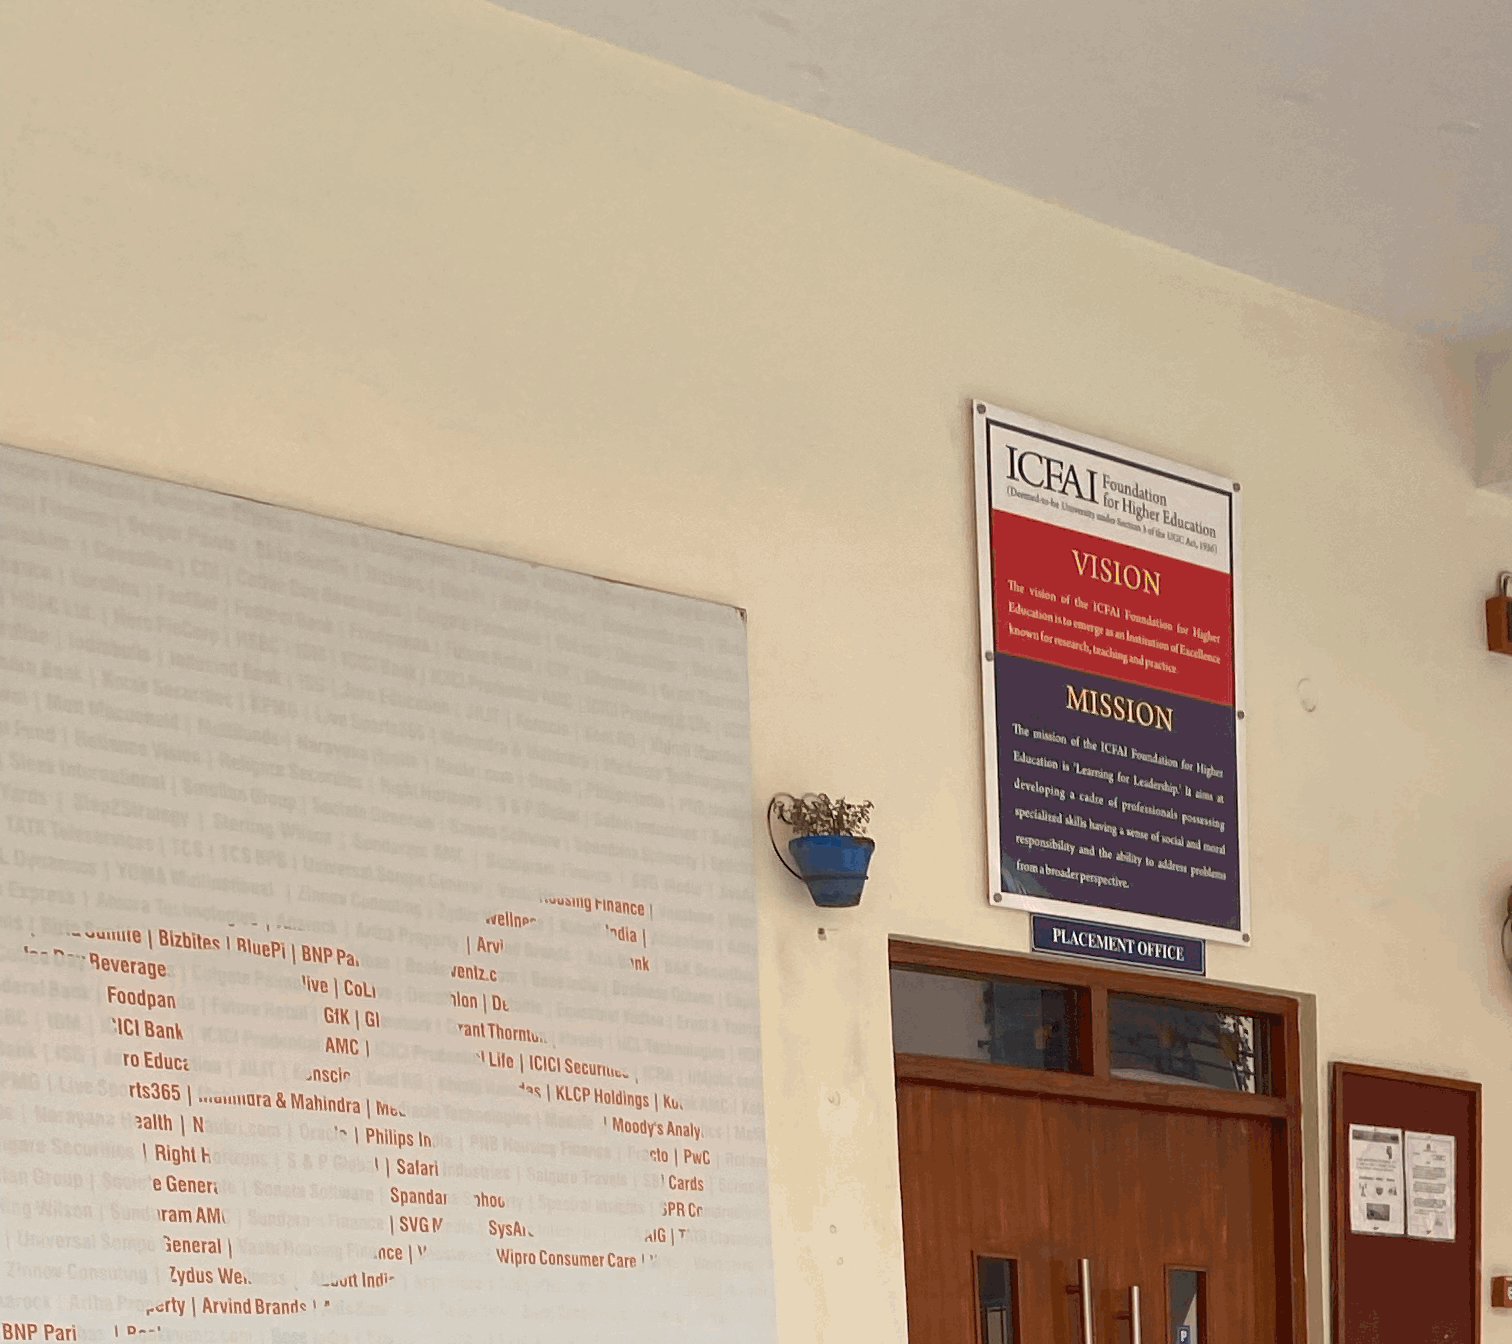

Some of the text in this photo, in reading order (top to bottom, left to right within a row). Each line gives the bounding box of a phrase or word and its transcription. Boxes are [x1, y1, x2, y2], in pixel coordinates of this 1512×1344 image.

[1005, 444, 1098, 504] ICFAI
[1102, 473, 1166, 506] Foundation
[1103, 491, 1215, 538] for Higher Education
[1072, 548, 1160, 596] VISION
[1007, 579, 1220, 646] The vision of the ICFAI Foundation for Higher
[1008, 601, 1220, 664] Education is to emerge as an Institution of Excellence
[1008, 622, 1039, 641] known
[1040, 630, 1053, 644] for
[1054, 634, 1091, 655] research,
[1092, 643, 1128, 665] teaching
[1129, 652, 1143, 666] and
[1066, 684, 1173, 732] MISSION
[1012, 722, 1223, 781] The mission of the ICFAI Foundation for Higher
[1012, 749, 1058, 770] Education
[1062, 760, 1069, 772] is
[1117, 771, 1129, 784] for
[1185, 785, 1191, 797] It
[1195, 787, 1213, 801] aims
[1216, 792, 1223, 803] at
[1013, 777, 1225, 833] developing a cadre of professionals possessing
[1014, 804, 1225, 855] specialized skills having a sense of social and moral
[1015, 831, 1226, 883] responsibility and the ability to address problems
[1016, 858, 1038, 873] from
[1039, 865, 1044, 874] a
[1045, 863, 1079, 880] broader
[158, 928, 220, 952] Bizbites
[1052, 927, 1185, 962] PLACEMENT OFFICE
[301, 944, 332, 964] BNP
[144, 1020, 183, 1040] Bank
[325, 1036, 358, 1055] AMC
[489, 1051, 514, 1069] Life
[529, 1055, 561, 1073] ICICI
[275, 1092, 360, 1114] & Mahindra
[556, 1085, 650, 1110] KLCP Holdings
[366, 1127, 414, 1149] Philips
[612, 1116, 664, 1138] Moody's
[155, 1144, 196, 1166] Right
[683, 1148, 710, 1165] PwC
[396, 1158, 438, 1176] Safari
[668, 1174, 704, 1191] Cards
[399, 1216, 429, 1233] SVG
[496, 1248, 636, 1269] Wipro Consumer Care
[169, 1265, 213, 1286] Zydus
[201, 1296, 251, 1314] Arvind
[2, 1322, 37, 1340] BNP
